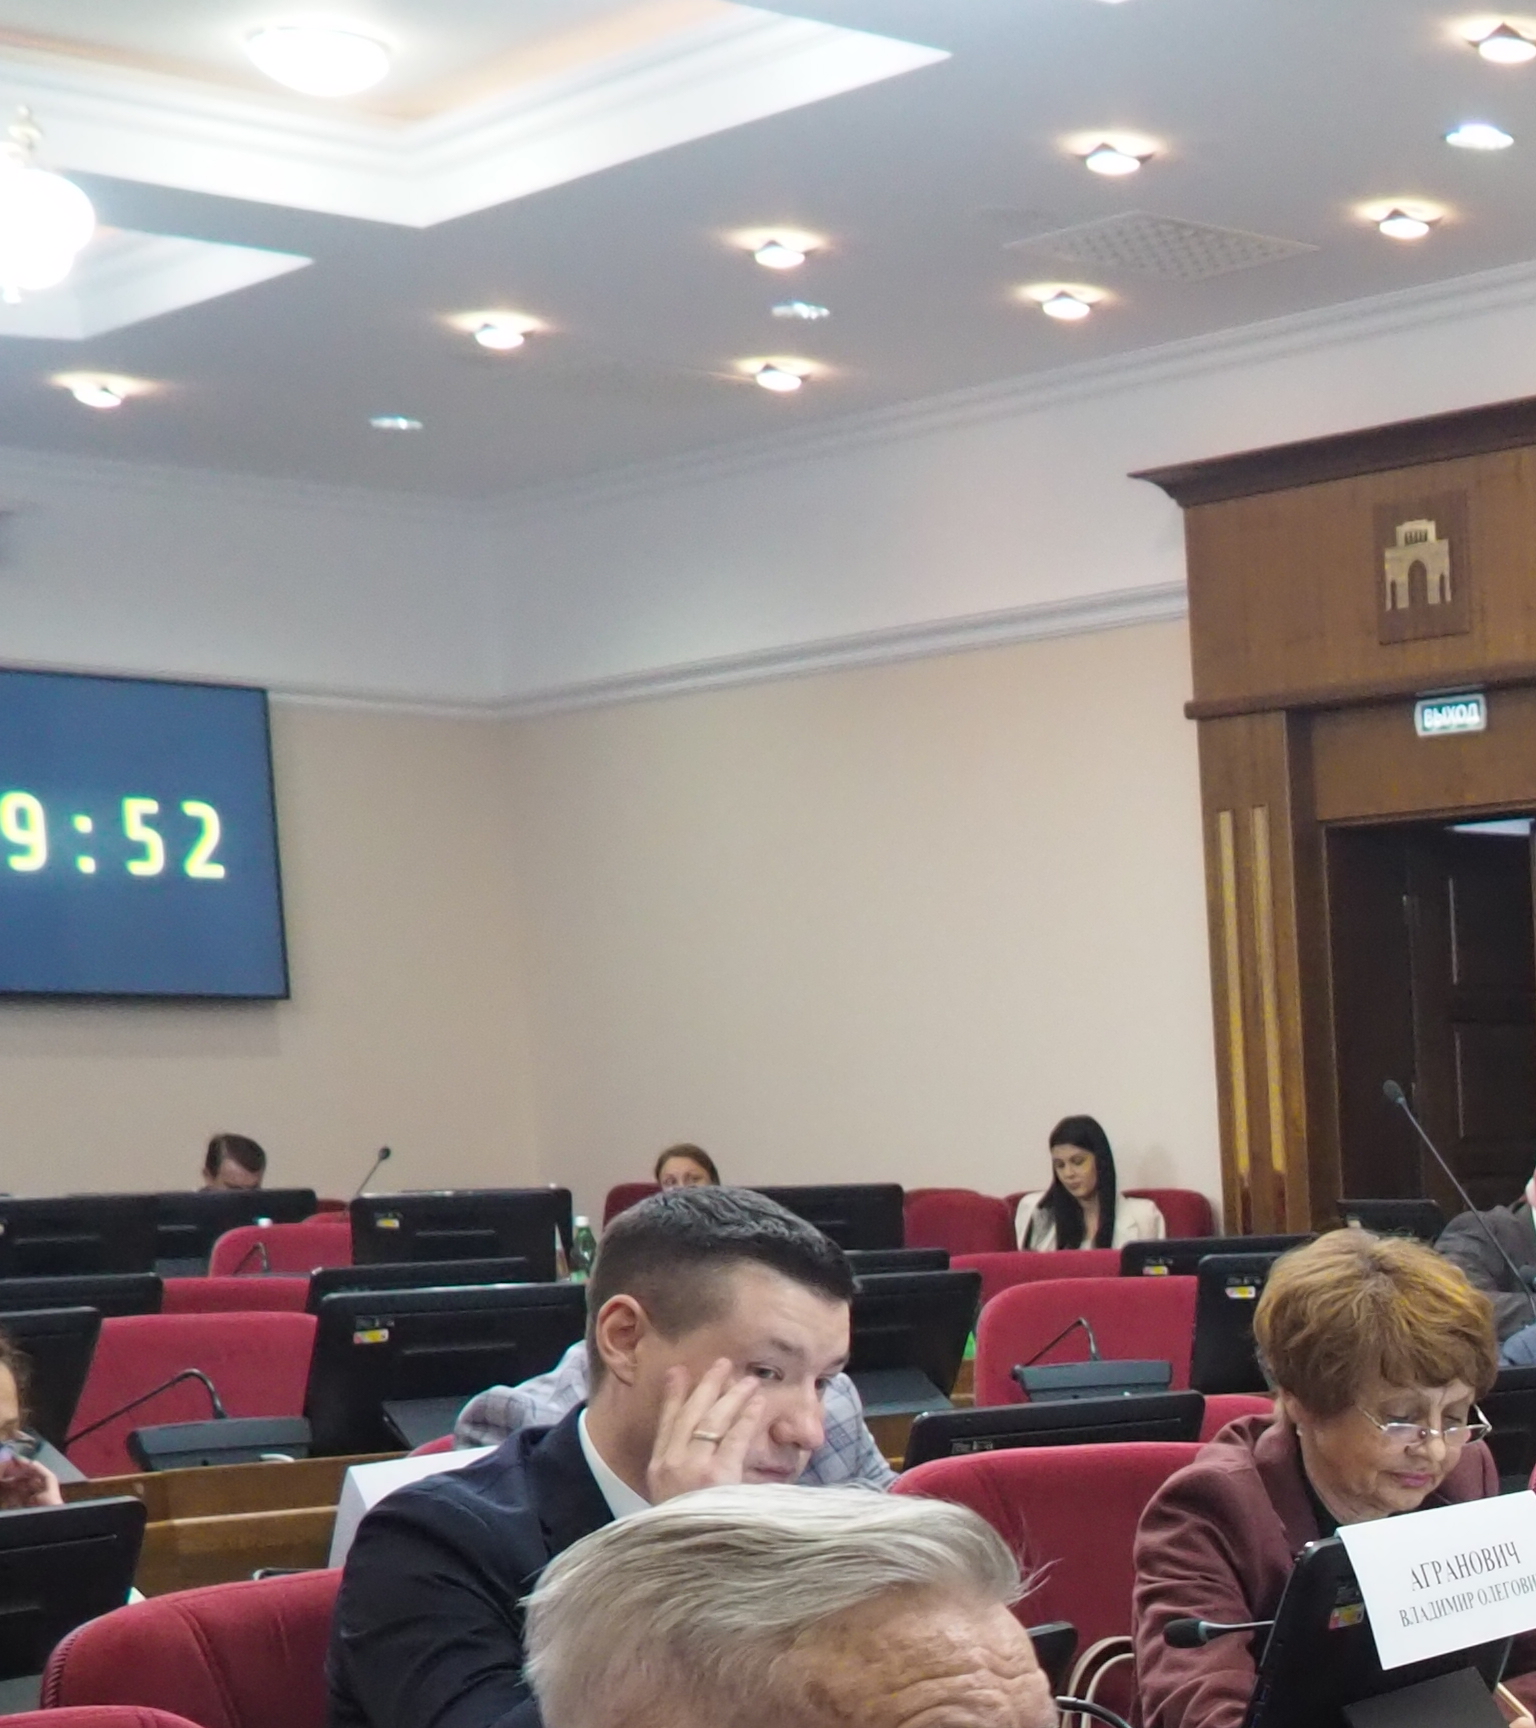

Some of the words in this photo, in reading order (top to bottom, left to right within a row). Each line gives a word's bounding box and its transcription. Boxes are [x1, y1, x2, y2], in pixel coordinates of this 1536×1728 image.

[1423, 702, 1480, 729] ВЫХОД
[1409, 1541, 1522, 1592] АГРАНОВИЧ
[1398, 1591, 1475, 1628] ВЛАДИМИР
